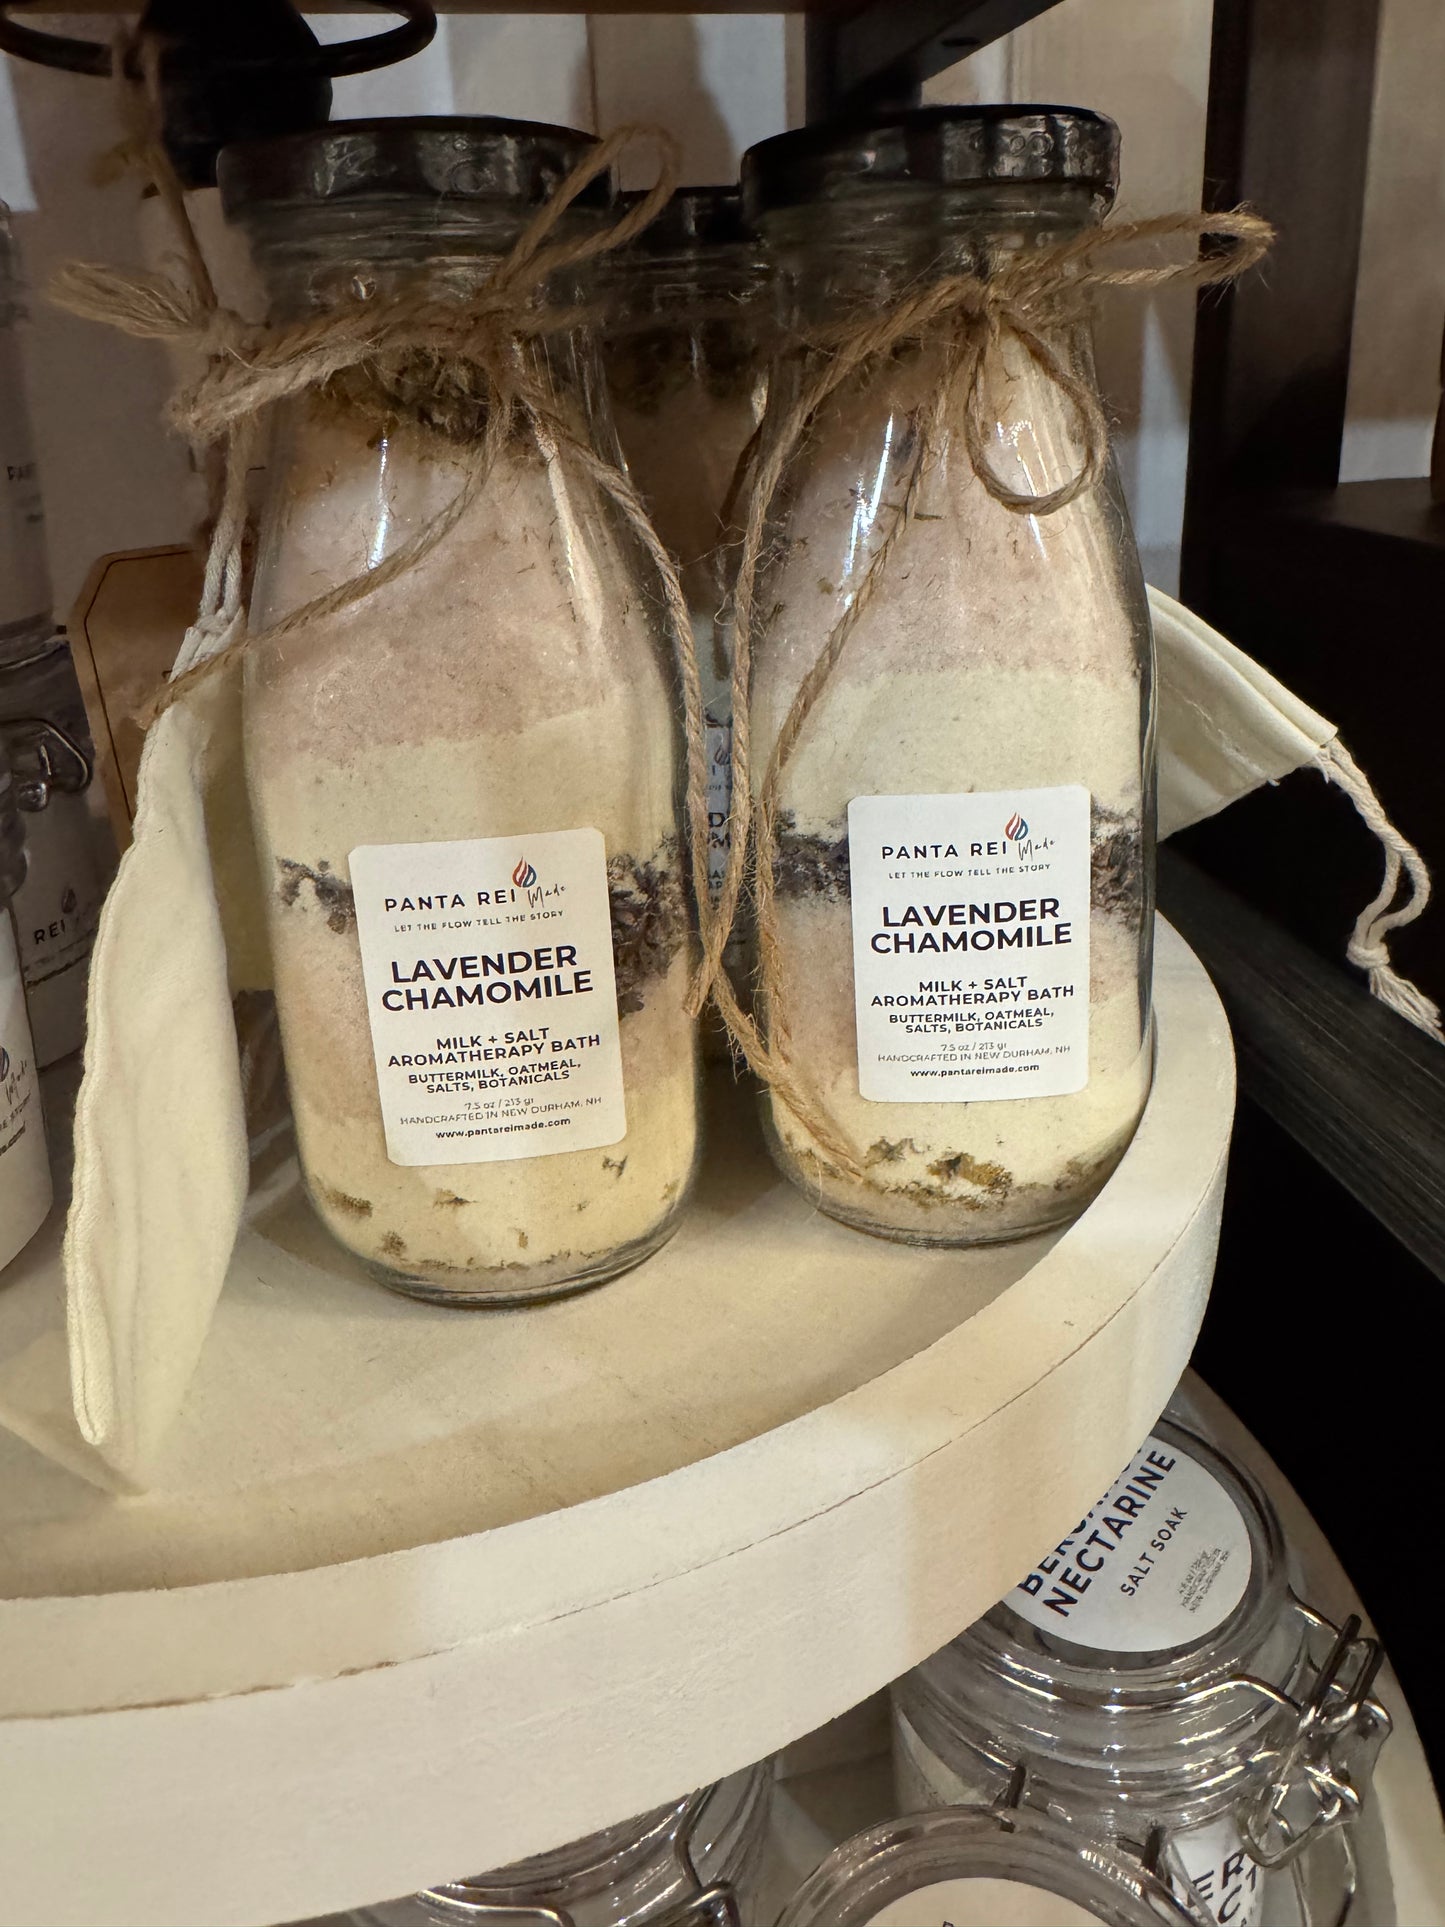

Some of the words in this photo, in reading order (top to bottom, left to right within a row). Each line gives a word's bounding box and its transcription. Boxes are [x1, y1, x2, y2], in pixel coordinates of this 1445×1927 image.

[881, 844, 958, 860] PANTA
[970, 841, 1007, 857] REI
[968, 868, 991, 876] TELL
[996, 866, 1014, 874] THE
[1019, 863, 1051, 873] STORY
[385, 894, 465, 912] PANTA
[477, 888, 516, 906] REI
[395, 924, 412, 932] LET
[442, 920, 472, 929] FLOW
[476, 917, 502, 926] TELL
[505, 914, 526, 922] THE
[530, 910, 564, 921] STORY
[882, 898, 1060, 927] LAVENDER
[34, 919, 66, 945] REI
[871, 922, 1072, 954] CHAMOMILE
[391, 945, 578, 984] LAVENDER
[381, 970, 594, 1012] CHAMOMILE
[871, 990, 1021, 1007] AROMATHERAPY
[1027, 985, 1074, 1001] BATH
[919, 980, 962, 993] MILK
[968, 981, 978, 990] +
[984, 976, 1028, 990] SALT
[889, 1012, 981, 1024] BUTTERMILK,
[984, 1007, 1054, 1021] OATMEAL,
[905, 1024, 951, 1034] SALTS,
[955, 1018, 1043, 1032] BOTANICALS
[388, 1042, 545, 1067] AROMATHERAPY
[551, 1034, 600, 1053] BATH
[436, 1035, 482, 1051] MILK
[488, 1035, 498, 1044] +
[504, 1027, 550, 1044] SALT
[878, 1053, 958, 1062] HANDCRAFTED
[975, 1051, 1000, 1060] NEW
[1055, 1045, 1070, 1053] NH
[408, 1067, 504, 1084] BUTTERMILK,
[508, 1058, 581, 1076] OATMEAL,
[427, 1081, 474, 1094] SALTS,
[478, 1070, 570, 1090] BOTANICALS
[910, 1064, 1040, 1078] www.pantareimade.com
[400, 1111, 483, 1125] HANDCRAFTED
[487, 1110, 498, 1119] IN
[501, 1107, 528, 1117] NEW
[585, 1097, 601, 1106] NH
[435, 1117, 571, 1138] www.pantareimade.com
[1042, 1450, 1176, 1617] NECTARINE
[1120, 1552, 1155, 1596] SALT
[1151, 1507, 1188, 1551] SOAK
